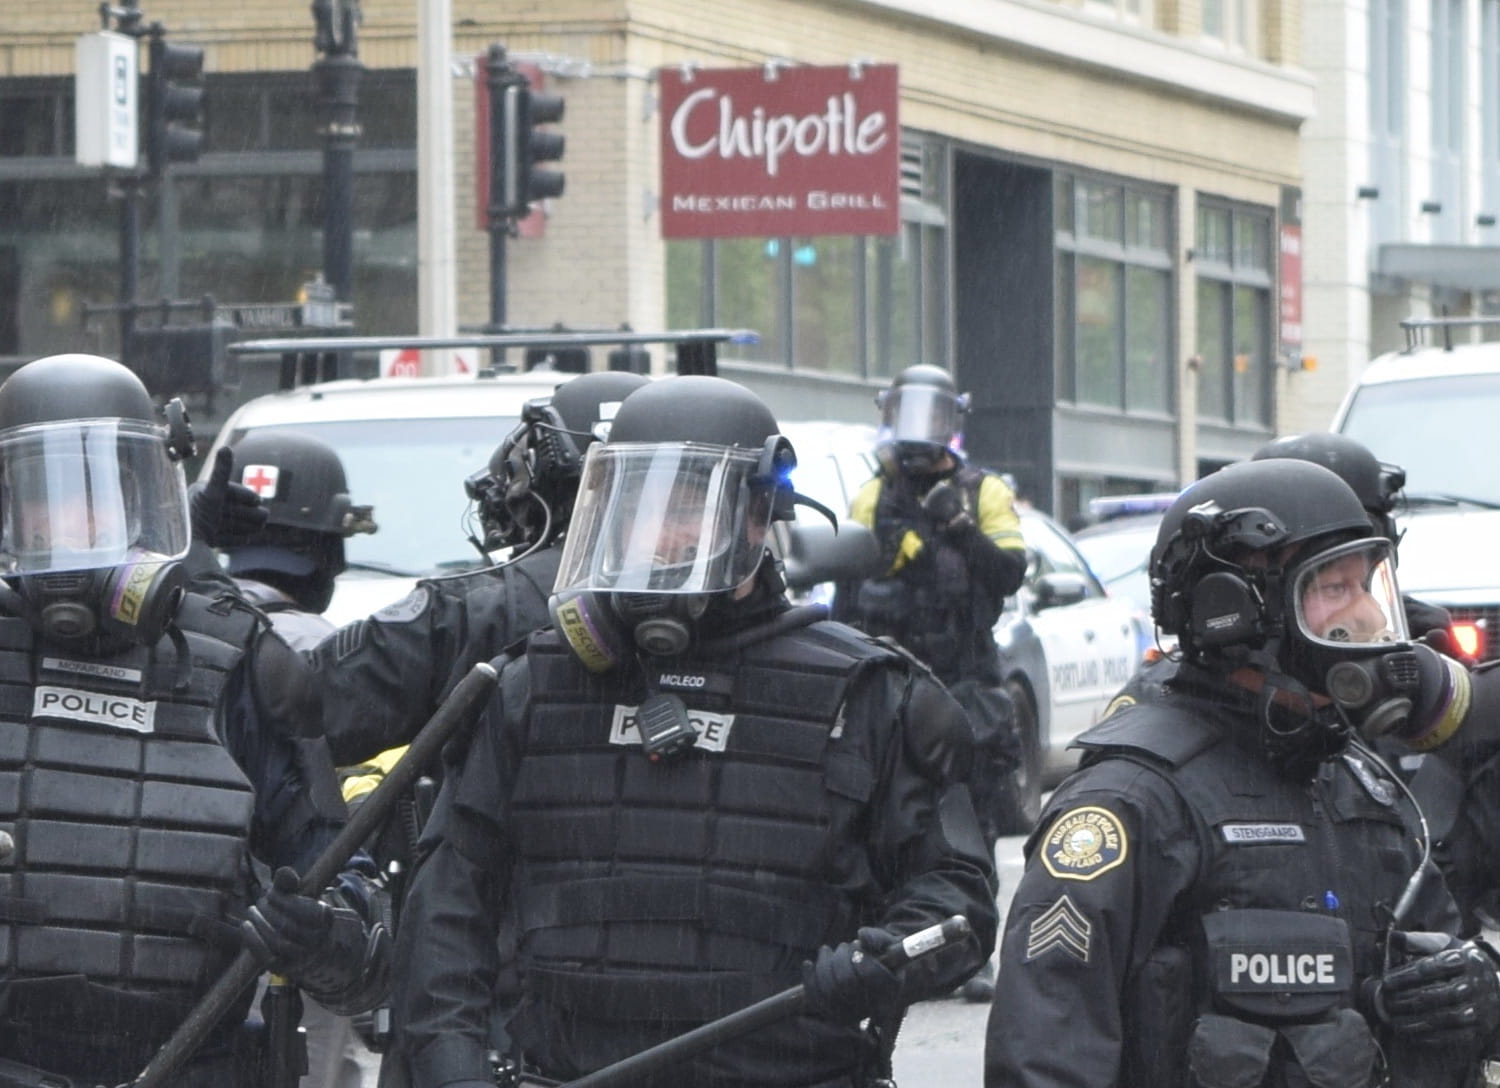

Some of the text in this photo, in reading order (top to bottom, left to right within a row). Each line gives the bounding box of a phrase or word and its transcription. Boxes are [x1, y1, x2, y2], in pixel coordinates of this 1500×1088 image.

[670, 87, 889, 176] Chipotle
[672, 190, 887, 213] MEXICAN GRILL
[57, 660, 128, 680] MCFARLAND
[659, 673, 706, 688] MCLEOD
[41, 692, 148, 727] POLICE
[619, 714, 724, 743] PCE
[1050, 814, 1086, 846] BUREAU
[1096, 816, 1119, 851] POLICE
[1231, 826, 1298, 839] STENSGAARD
[1230, 953, 1336, 985] POLICE
